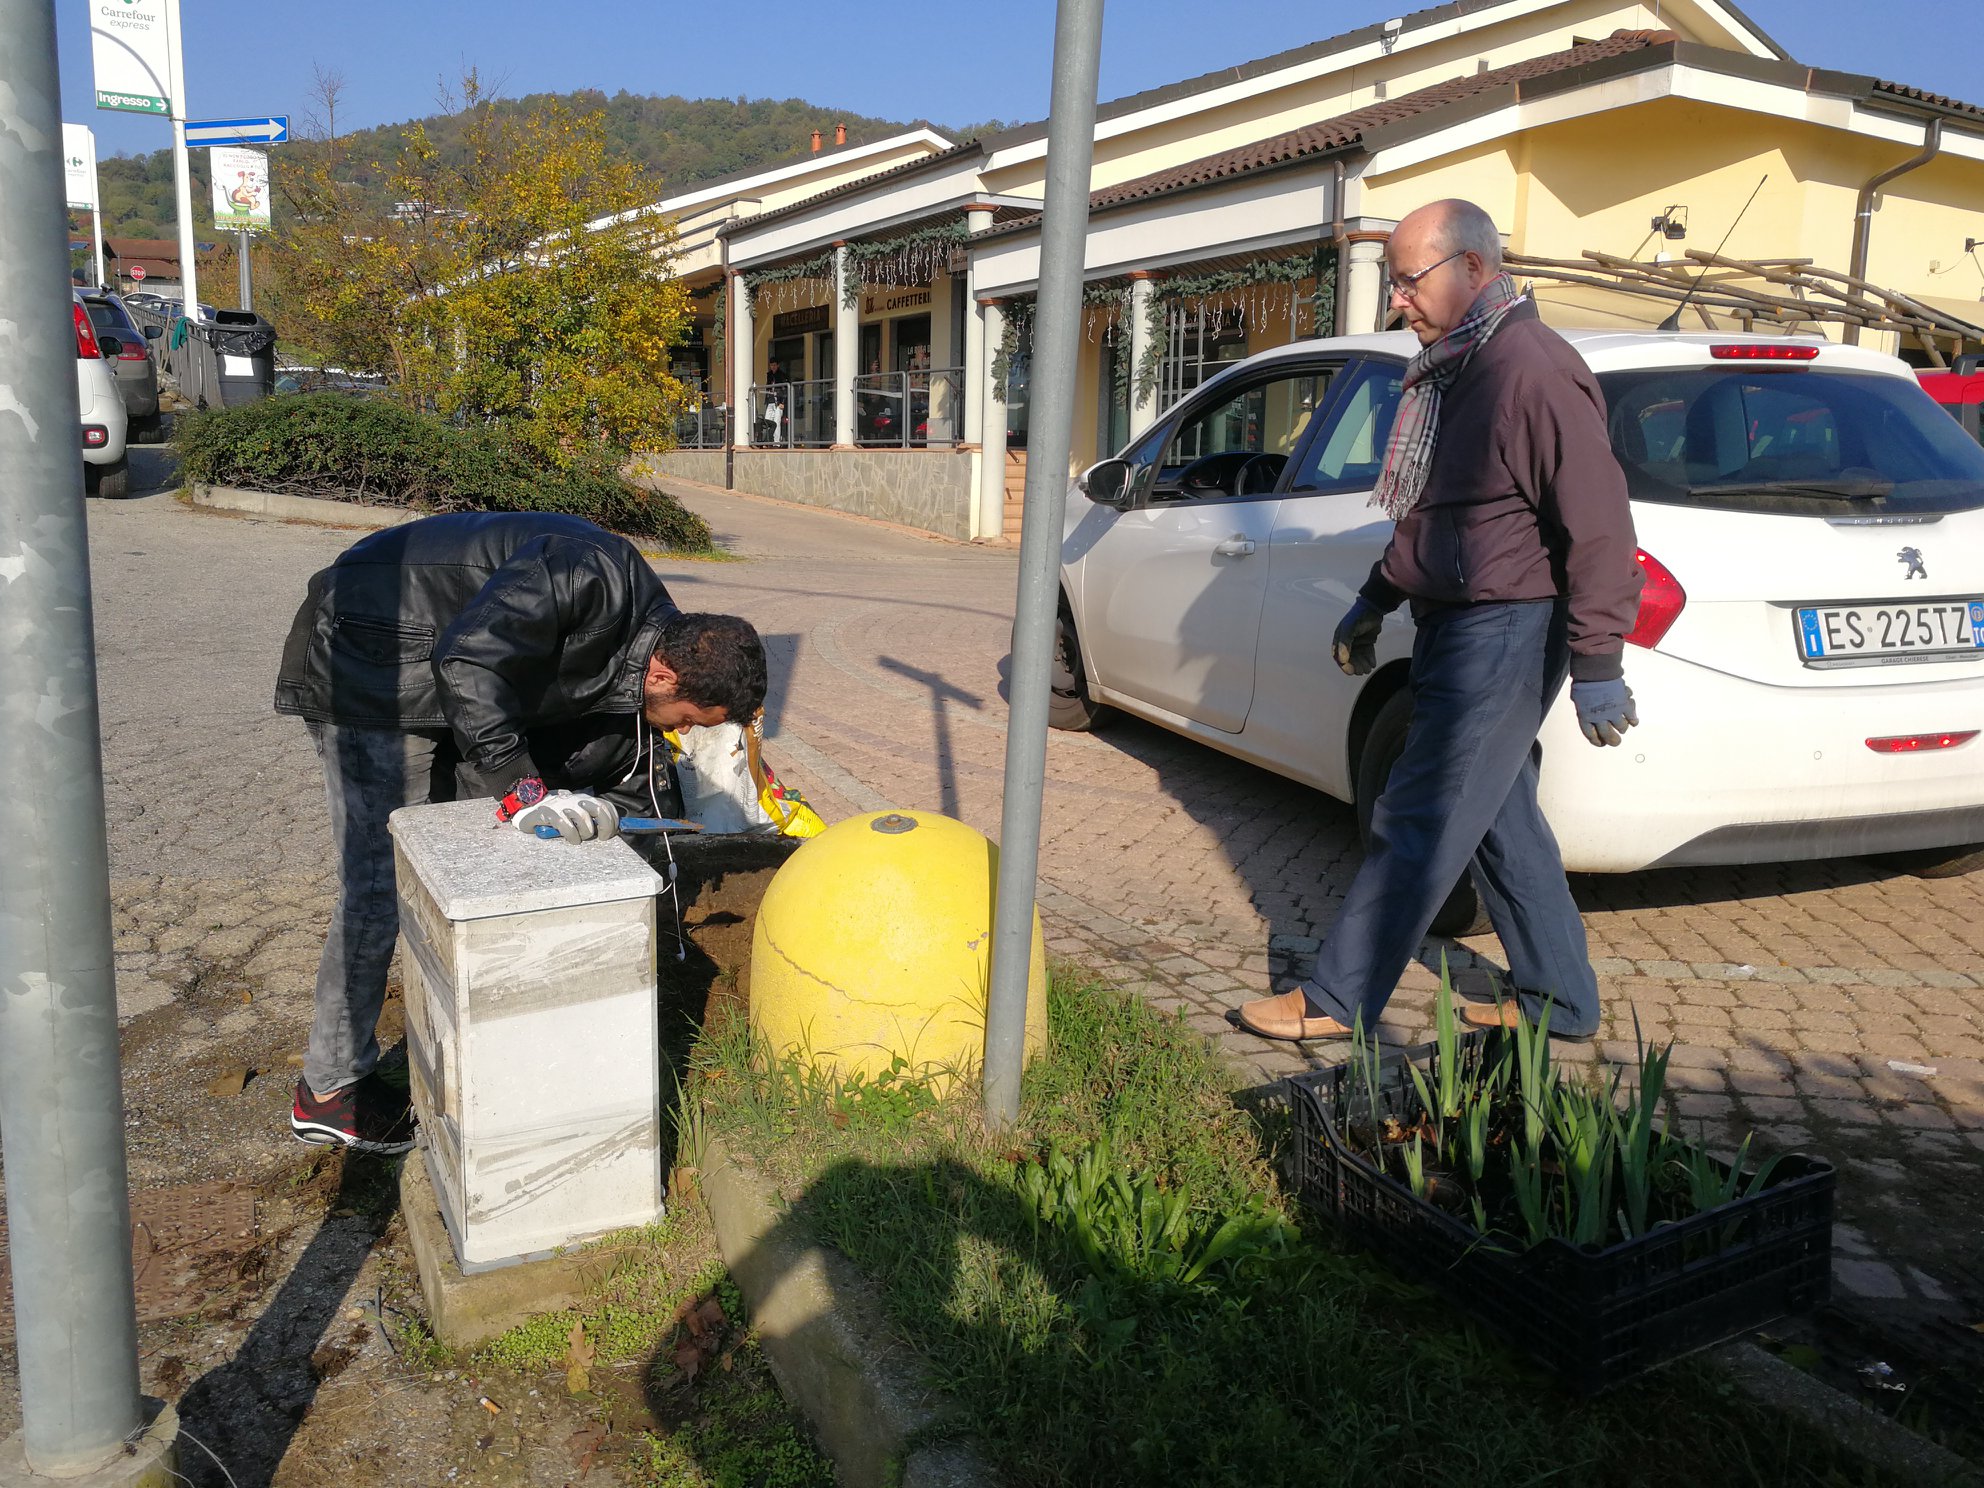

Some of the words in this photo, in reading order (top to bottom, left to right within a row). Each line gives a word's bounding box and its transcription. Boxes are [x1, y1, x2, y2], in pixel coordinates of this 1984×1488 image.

[101, 6, 156, 22] Carrefour
[110, 19, 150, 31] express
[98, 92, 151, 107] Ingresso
[131, 269, 145, 277] STOP
[886, 291, 931, 311] CAFFETTERI
[1824, 611, 1865, 649] ES
[1876, 607, 1970, 648] 225TZ
[1881, 656, 1904, 664] GARAGE
